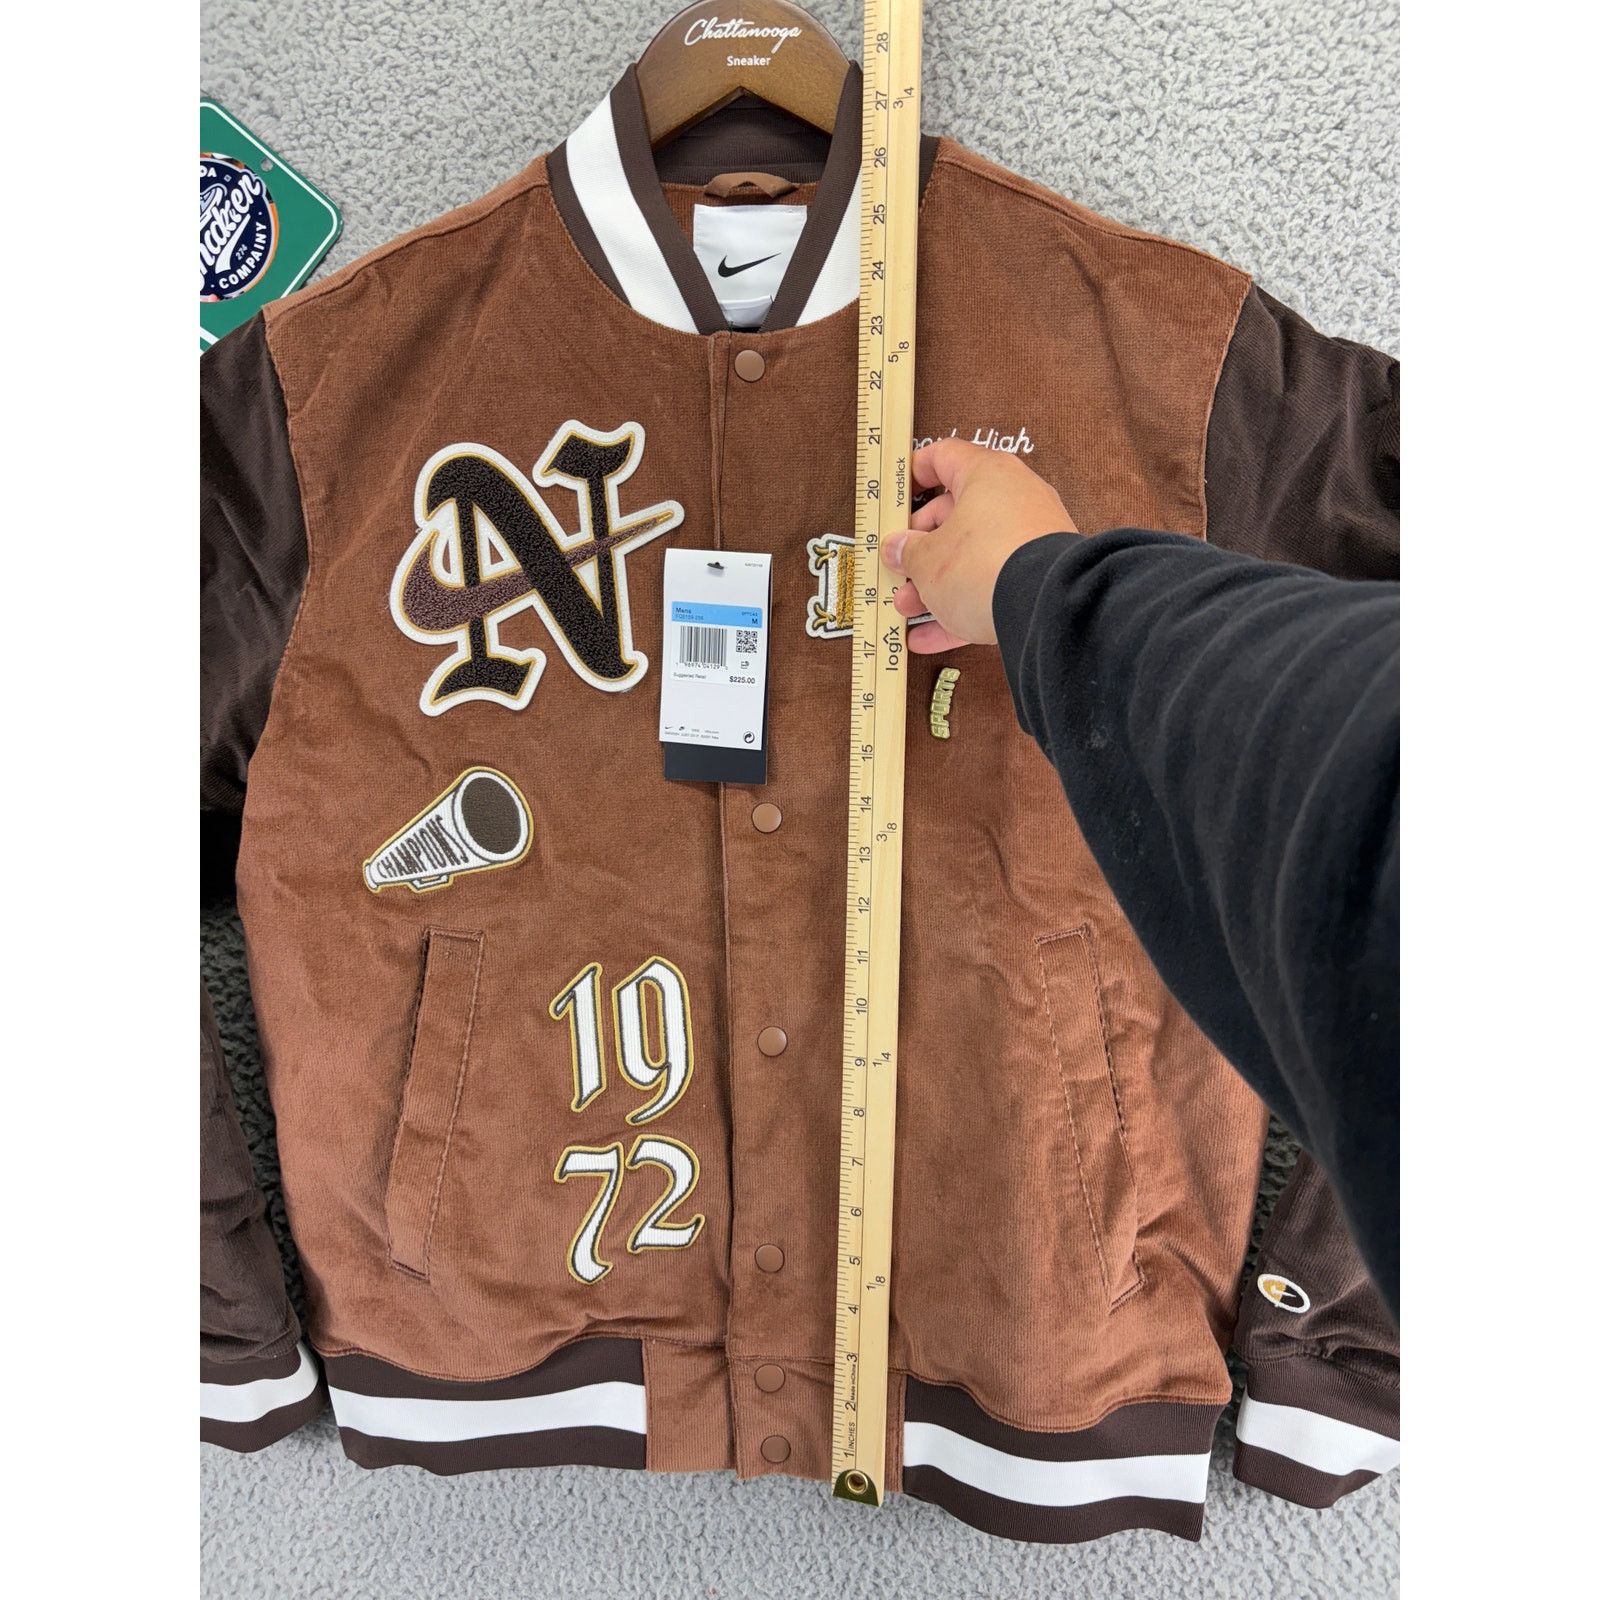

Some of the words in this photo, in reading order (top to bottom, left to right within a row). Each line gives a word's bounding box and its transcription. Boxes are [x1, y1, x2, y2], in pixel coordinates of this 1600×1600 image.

[684, 17, 802, 54] Chattanooga
[876, 32, 889, 53] 28
[727, 55, 771, 66] Sneaker
[875, 91, 887, 110] 27
[874, 147, 887, 168] 26
[873, 204, 885, 224] 25
[872, 260, 884, 280] 24
[871, 315, 883, 335] 23
[870, 370, 882, 390] 22
[868, 427, 881, 445] 21
[867, 479, 879, 499] 20
[896, 457, 906, 507] Yardstick
[866, 533, 878, 552] 19
[865, 587, 877, 606] 18
[864, 641, 876, 659] 17
[729, 676, 755, 684] $225.00
[863, 693, 875, 710] 16
[930, 667, 961, 739] SPORTS
[862, 744, 873, 762] 15
[861, 795, 872, 813] 14
[377, 814, 469, 879] CHAMPIONS
[859, 846, 871, 863] 13
[858, 896, 870, 914] 12
[857, 949, 868, 964] 11
[856, 998, 867, 1015] 10
[550, 956, 694, 1126] 19
[855, 1058, 866, 1067] 9
[854, 1108, 865, 1117] 8
[852, 1158, 863, 1167] 7
[554, 1134, 705, 1284] 72
[851, 1207, 862, 1217] 6
[849, 1256, 861, 1266] 5
[848, 1305, 859, 1315] 4
[847, 1353, 857, 1363] 3
[846, 1402, 856, 1411] 2
